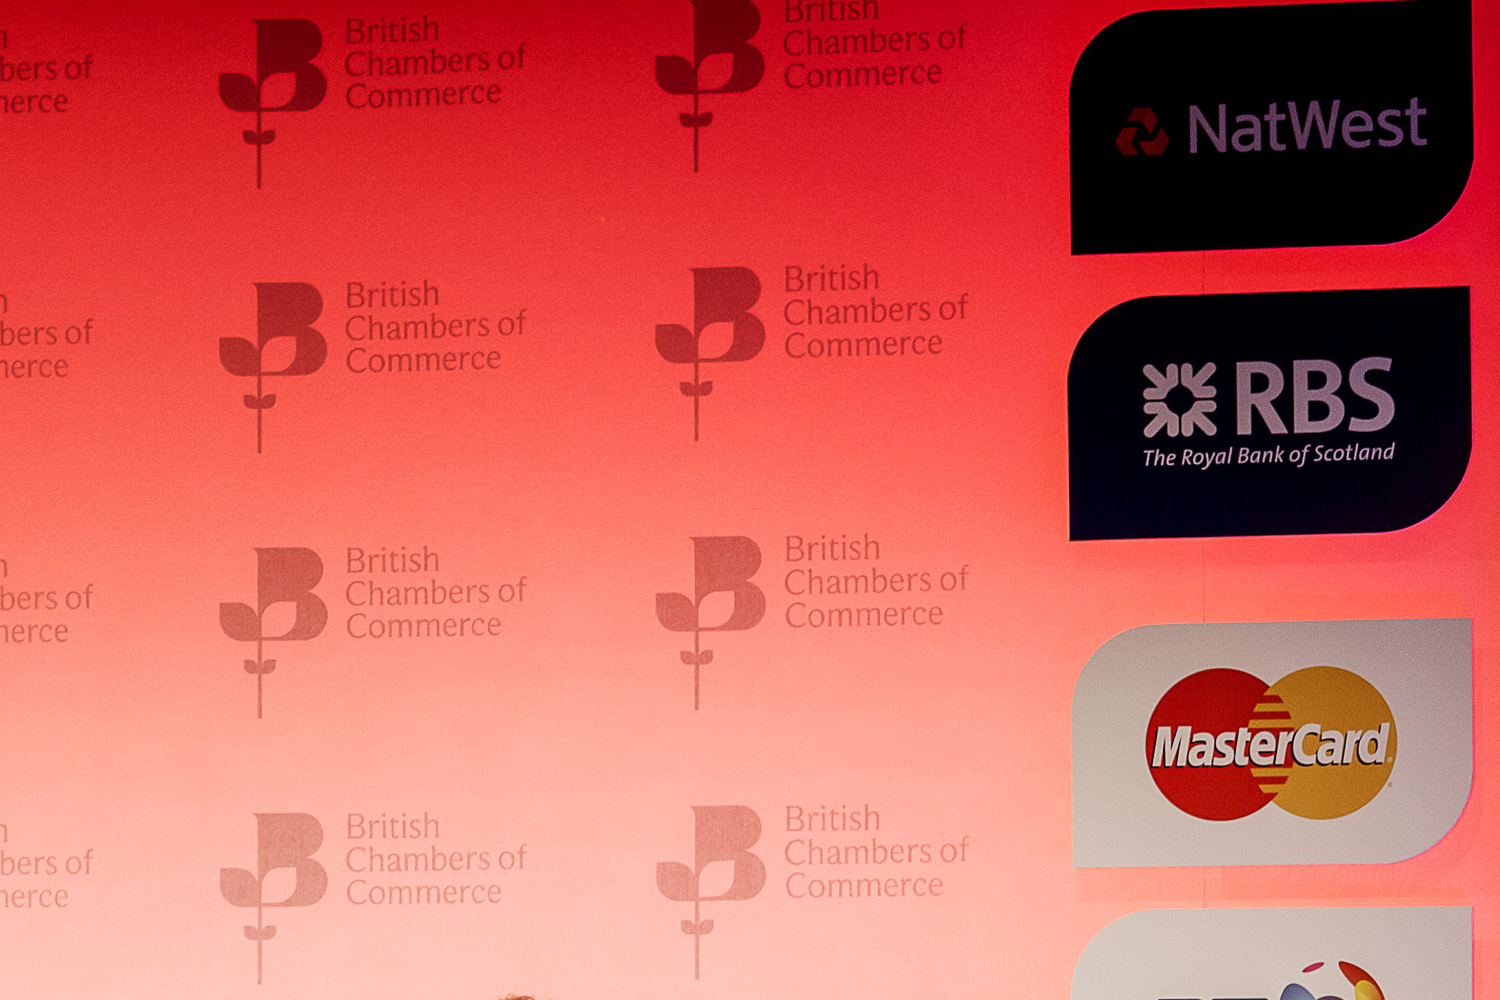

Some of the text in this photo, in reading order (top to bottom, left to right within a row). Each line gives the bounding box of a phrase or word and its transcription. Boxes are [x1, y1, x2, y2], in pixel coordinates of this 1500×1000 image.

[785, 0, 878, 23] British
[346, 15, 439, 44] British
[783, 22, 967, 56] Chambers of
[65, 53, 92, 80] of
[345, 43, 526, 77] Chambers of
[784, 63, 941, 89] Commerce
[346, 83, 501, 109] Commerce
[1188, 97, 1428, 154] NatWest
[785, 263, 879, 292] British
[346, 279, 439, 308] British
[784, 293, 968, 326] Chambers of
[65, 318, 94, 345] of
[345, 309, 526, 341] Chambers of
[785, 332, 942, 359] Commerce
[346, 347, 501, 374] Commerce
[1236, 356, 1396, 436] RBS
[1143, 442, 1396, 471] The Royal Bank of Scotland
[347, 546, 439, 573] British
[786, 533, 880, 562] British
[346, 576, 527, 606] Chambers of
[784, 564, 968, 595] Chambers of
[66, 583, 93, 610] of
[347, 613, 501, 639] Commerce
[785, 602, 943, 628] Commerce
[1150, 722, 1391, 768] MasterCard
[347, 812, 439, 839] British
[786, 804, 880, 831] British
[65, 848, 93, 875] of
[346, 844, 526, 873] Chambers of
[784, 835, 969, 866] Chambers of
[346, 879, 501, 905] Commerce
[785, 872, 943, 899] Commerce
